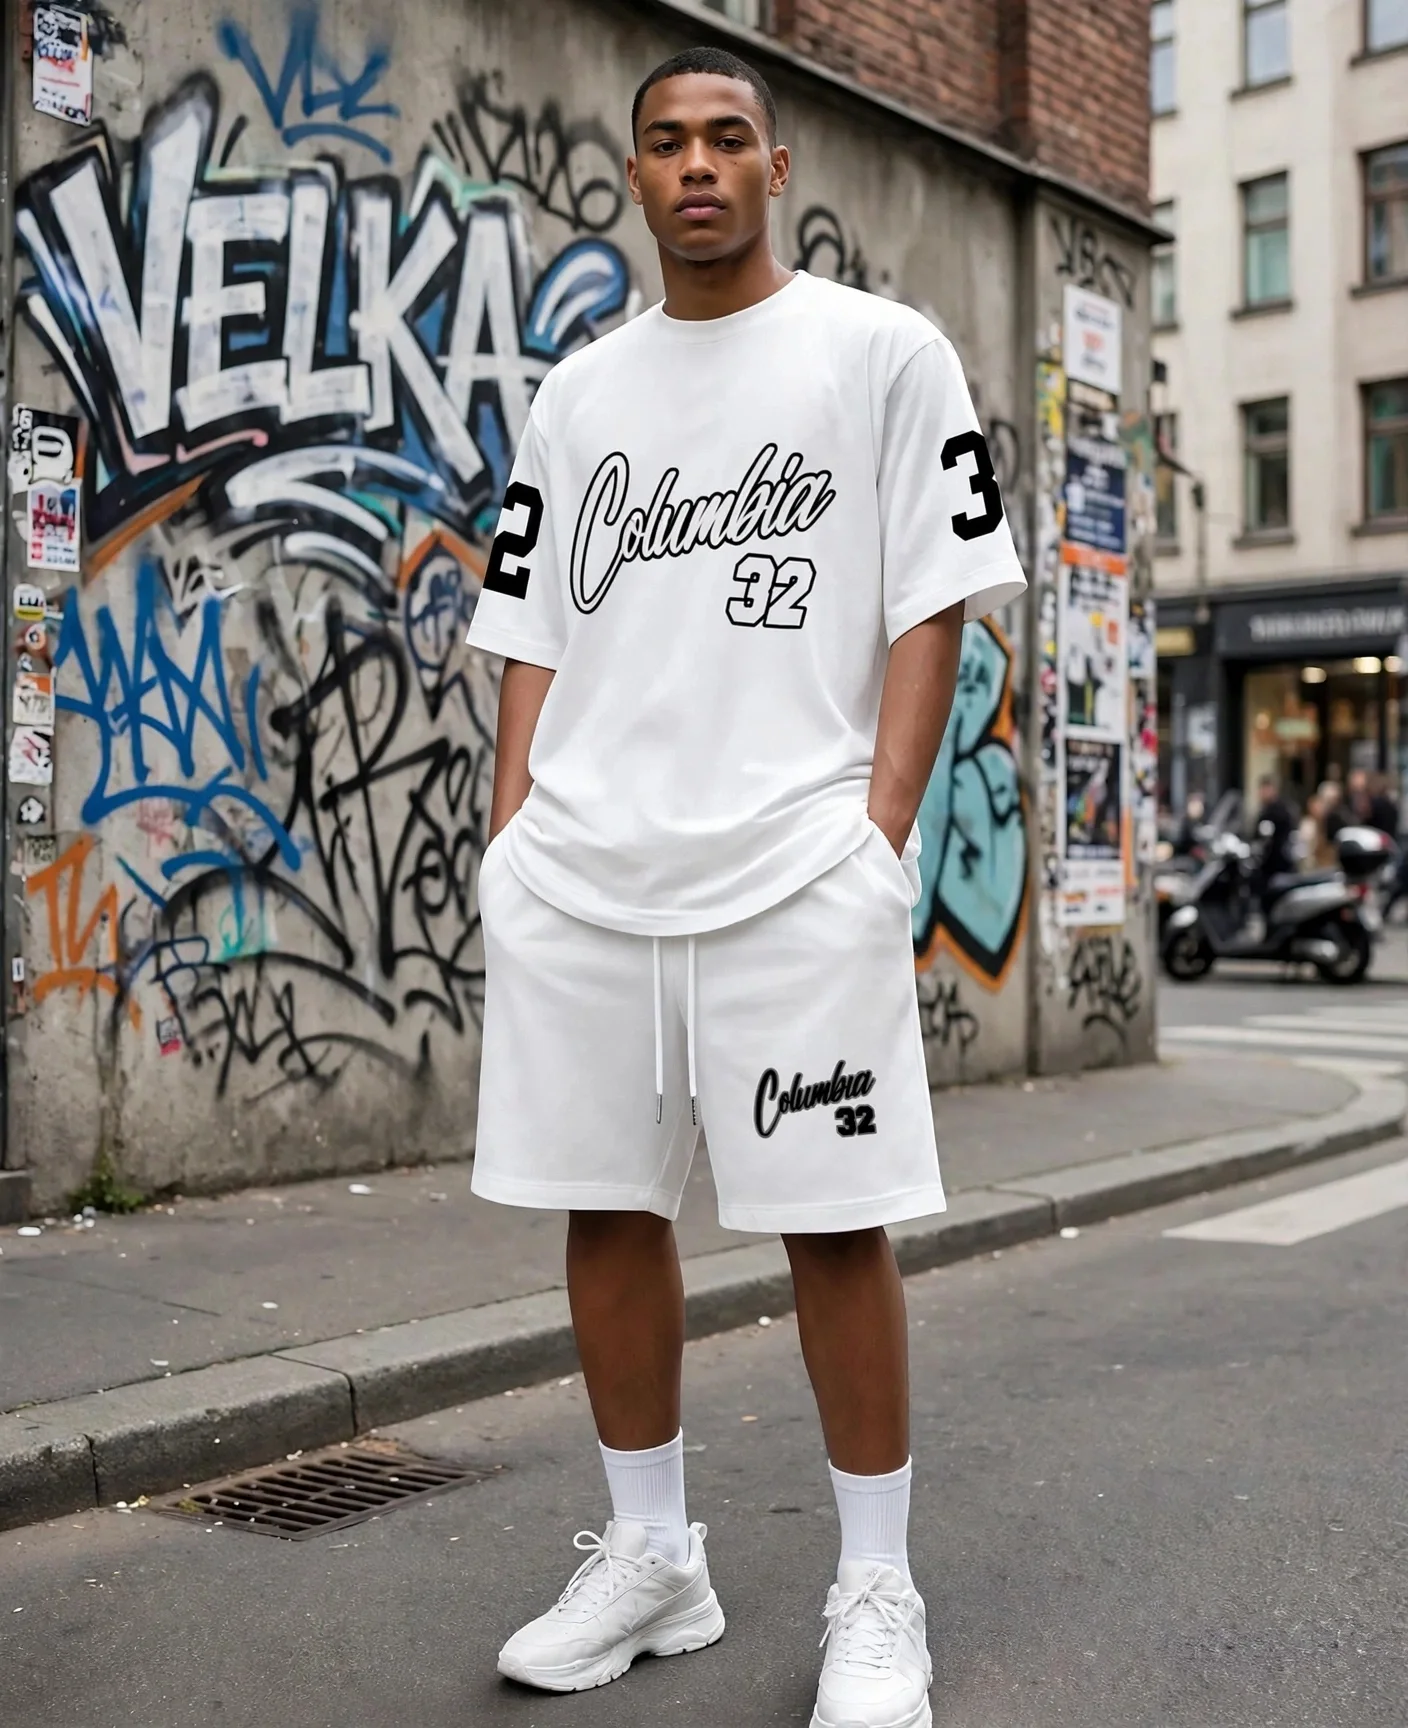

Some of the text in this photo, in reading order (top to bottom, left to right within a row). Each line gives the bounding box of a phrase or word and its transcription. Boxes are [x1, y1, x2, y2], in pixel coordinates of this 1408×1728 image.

[45, 98, 548, 484] VELKA
[482, 481, 545, 600] 2
[569, 442, 837, 615] Columbia
[941, 430, 1004, 542] 3
[725, 552, 817, 630] 32
[753, 1059, 877, 1139] Columbia
[834, 1104, 877, 1138] 32
